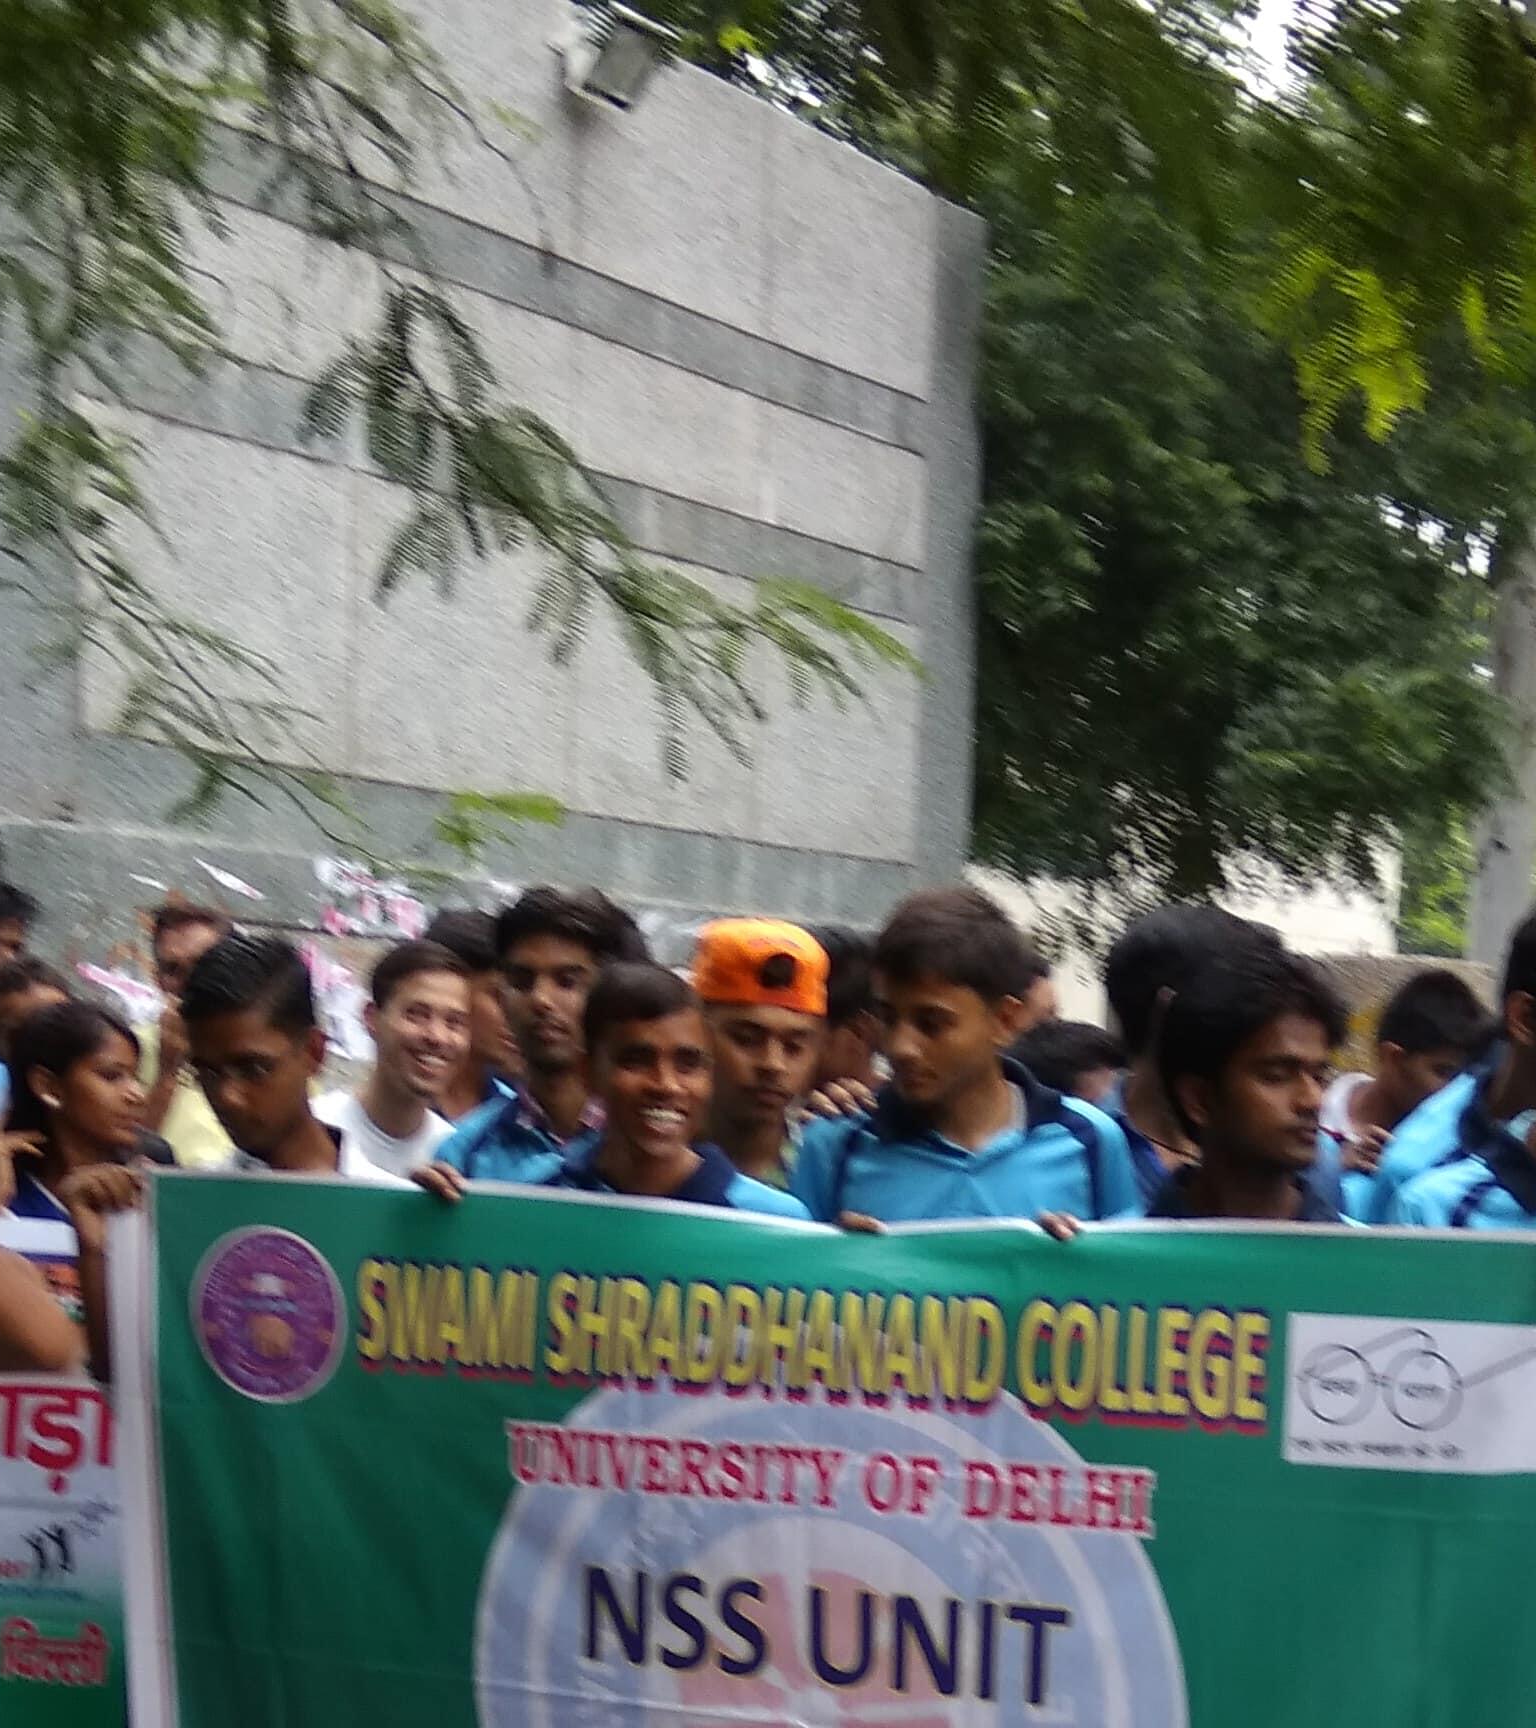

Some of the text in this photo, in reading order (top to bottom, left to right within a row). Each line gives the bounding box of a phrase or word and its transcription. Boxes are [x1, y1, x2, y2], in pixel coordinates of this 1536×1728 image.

[356, 1256, 540, 1380] SWAMI
[544, 1268, 1006, 1415] SHRADDHANAND
[1017, 1298, 1271, 1432] COLLEGE
[510, 1422, 1151, 1535] UNIVERSITY OF DELHI
[582, 1565, 1073, 1704] NSS UNIT
